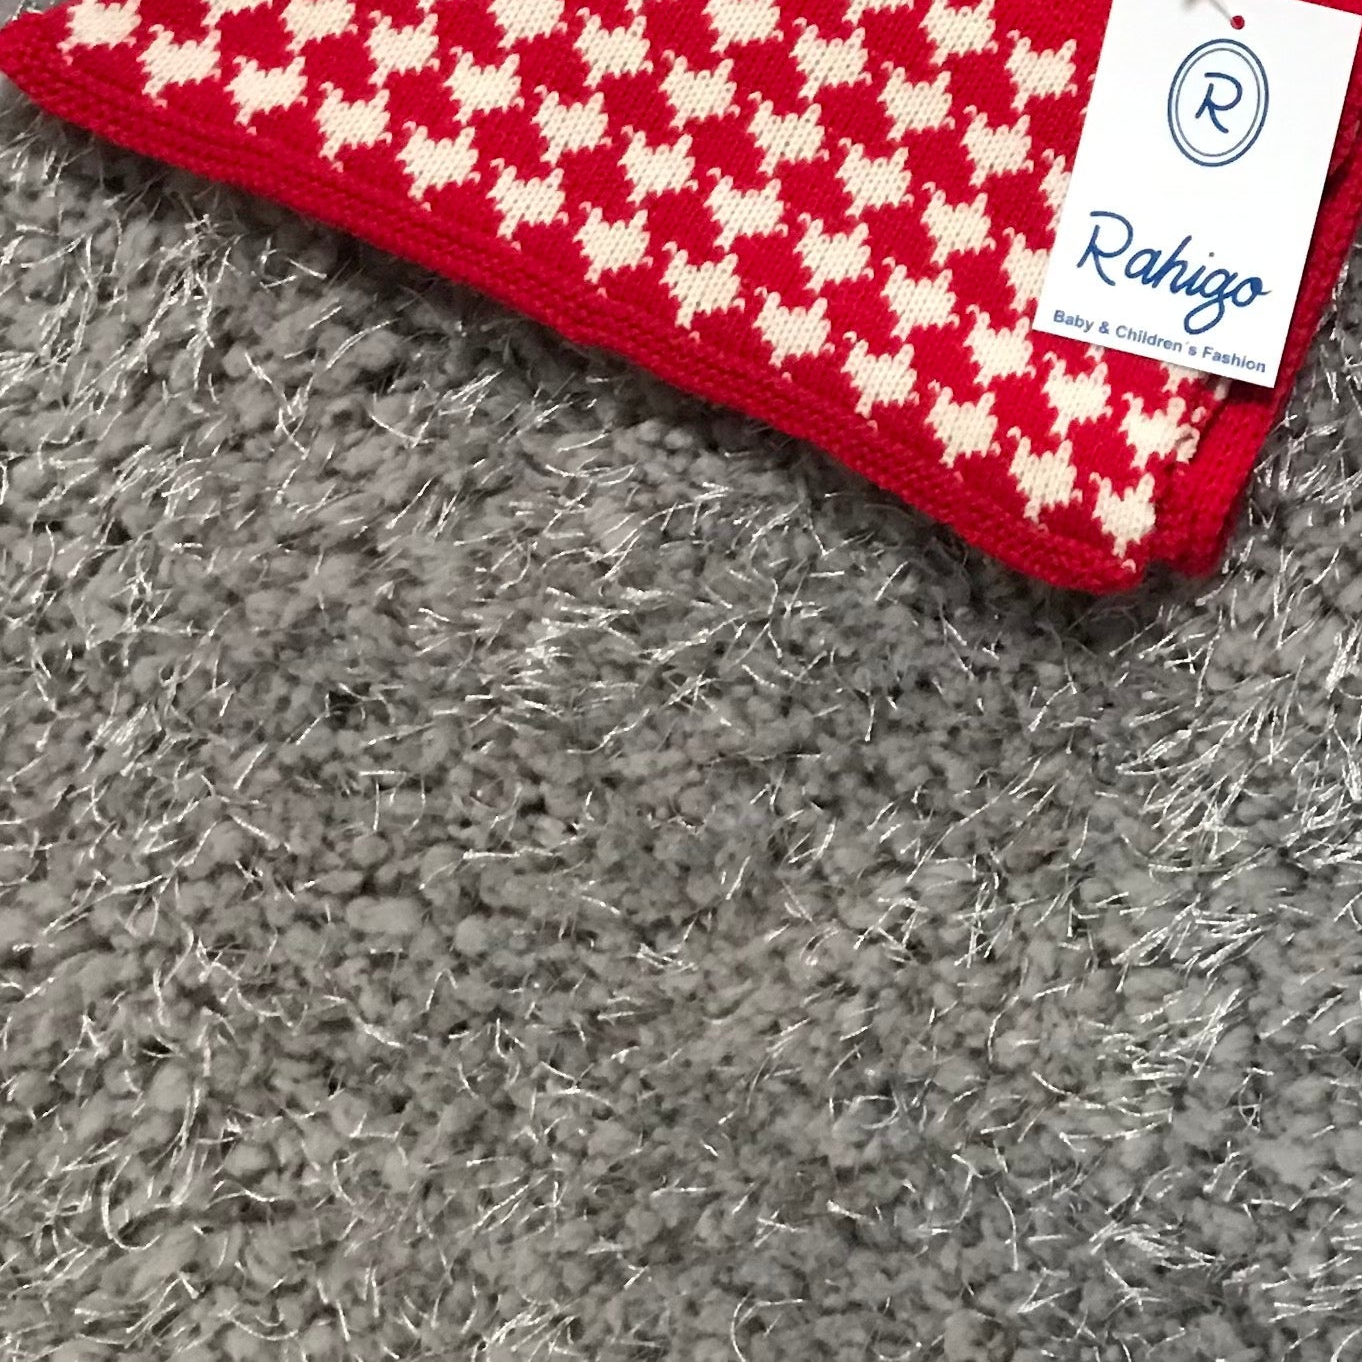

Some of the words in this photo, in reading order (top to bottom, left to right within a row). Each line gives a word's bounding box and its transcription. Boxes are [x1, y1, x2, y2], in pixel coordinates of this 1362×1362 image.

[1195, 71, 1243, 134] R
[1076, 210, 1272, 335] Rahigo
[1053, 309, 1094, 333] Baby
[1099, 321, 1110, 335] &
[1202, 346, 1266, 373] Fashion
